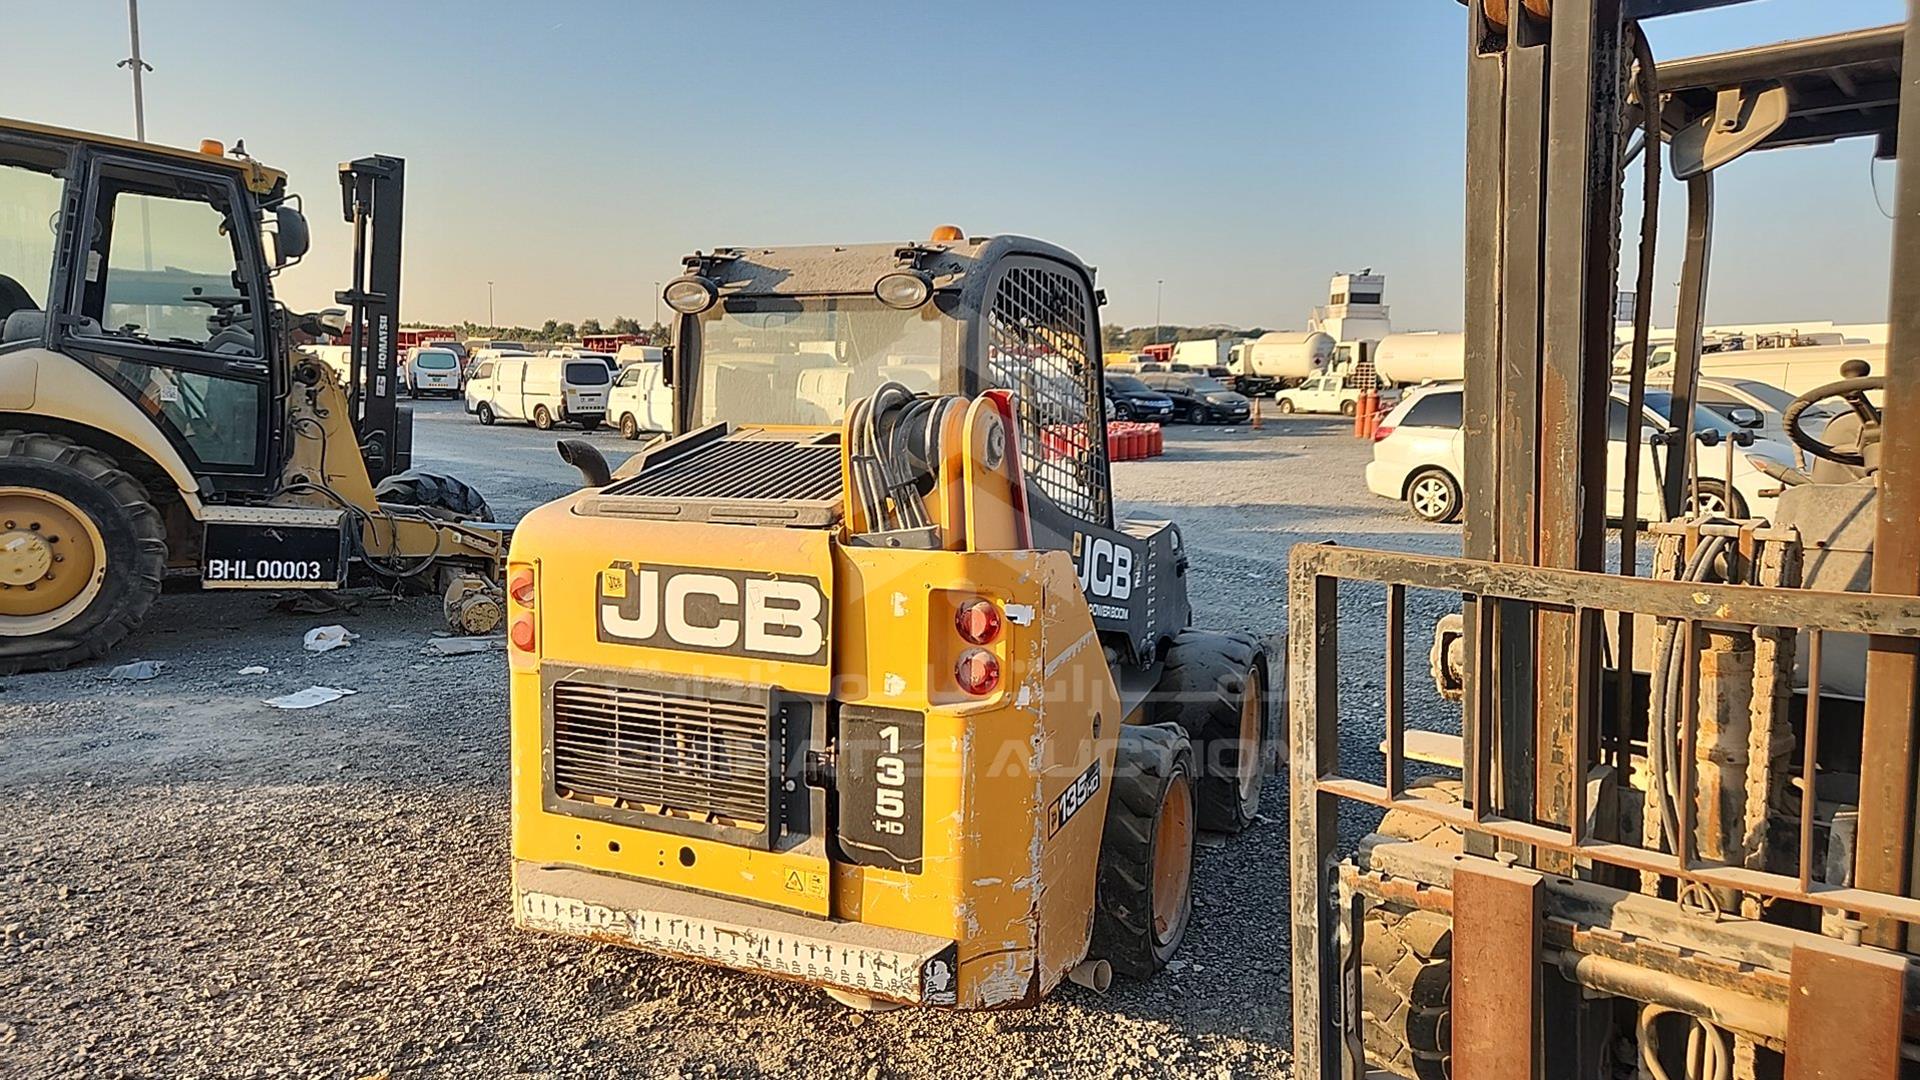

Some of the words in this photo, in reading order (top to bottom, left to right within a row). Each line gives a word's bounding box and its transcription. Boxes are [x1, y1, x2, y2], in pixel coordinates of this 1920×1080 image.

[377, 314, 388, 370] KOMATSU
[208, 559, 321, 579] BHL00003
[1073, 534, 1133, 600] JCB
[602, 570, 823, 656] JCB
